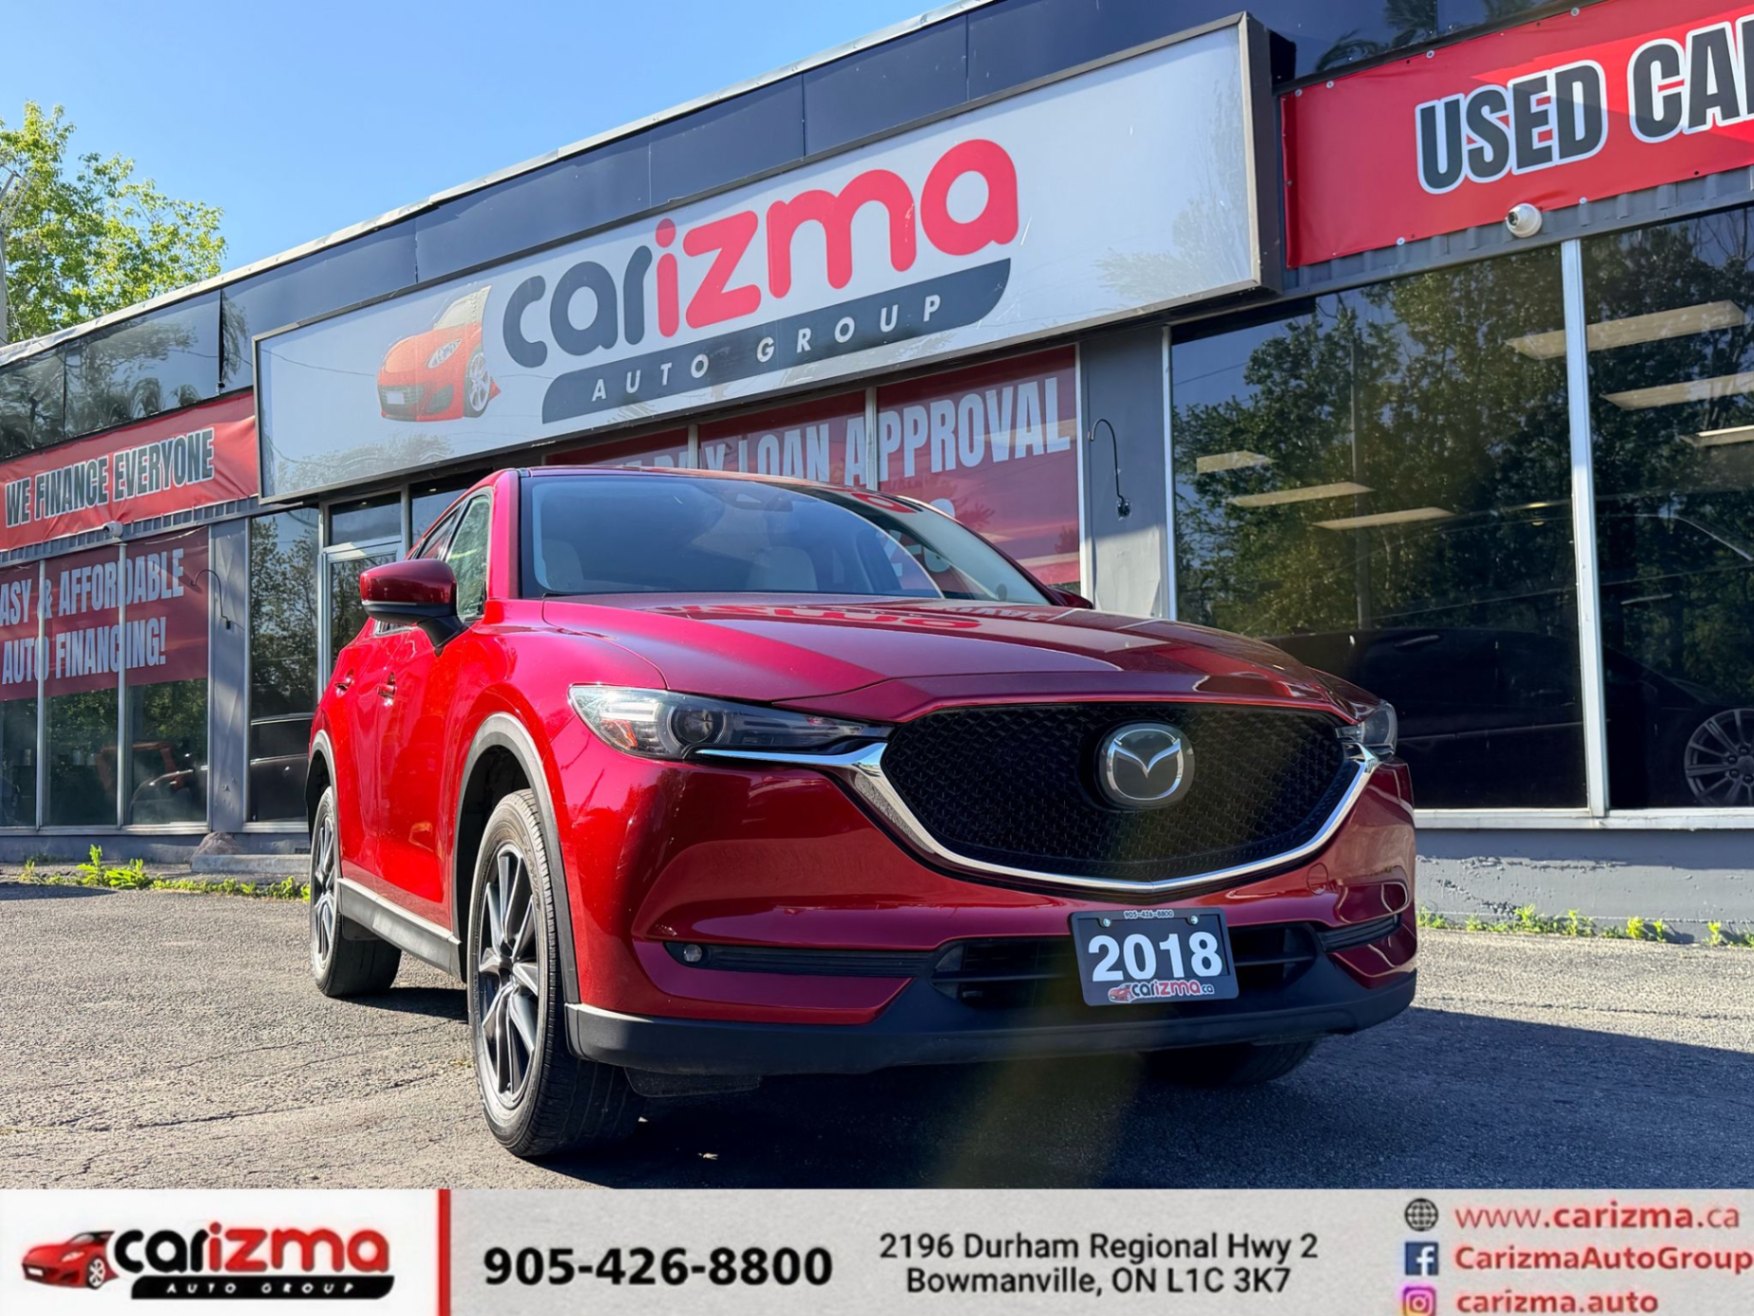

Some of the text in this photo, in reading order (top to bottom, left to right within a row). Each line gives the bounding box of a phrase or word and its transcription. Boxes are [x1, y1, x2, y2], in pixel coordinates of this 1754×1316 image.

[1416, 61, 1606, 193] USED
[503, 139, 1019, 368] carizma
[592, 294, 941, 401] AUTO GROUP
[5, 427, 215, 528] WE FINANCE EVERYONE
[844, 377, 1071, 487] APPROVAL
[59, 548, 184, 616] AFFORDABLE
[2, 616, 167, 684] AUTO FINANCING!
[1088, 931, 1222, 982] 2018
